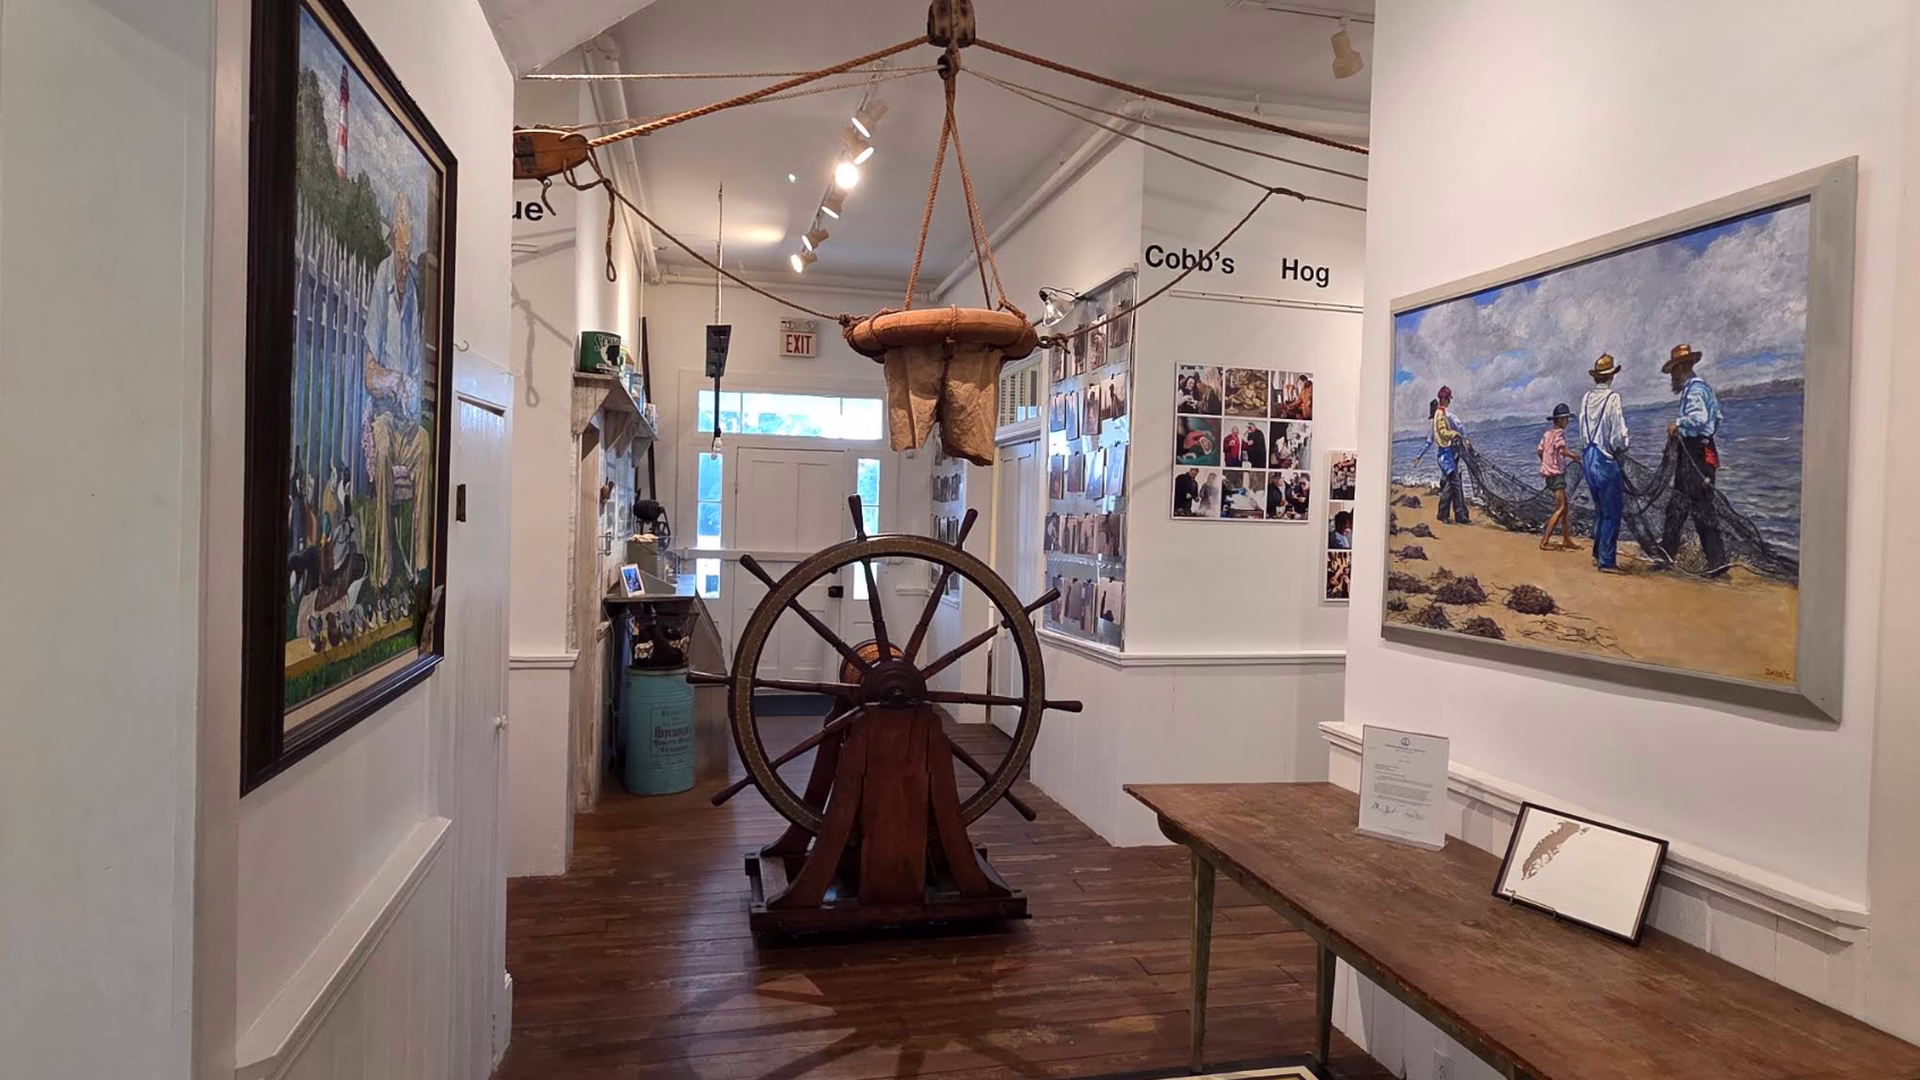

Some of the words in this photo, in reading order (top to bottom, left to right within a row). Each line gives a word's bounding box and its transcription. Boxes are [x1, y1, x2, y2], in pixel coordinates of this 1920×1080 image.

[1145, 245, 1235, 274] Cobb's
[1281, 257, 1329, 288] Hog
[786, 334, 812, 354] EXIT
